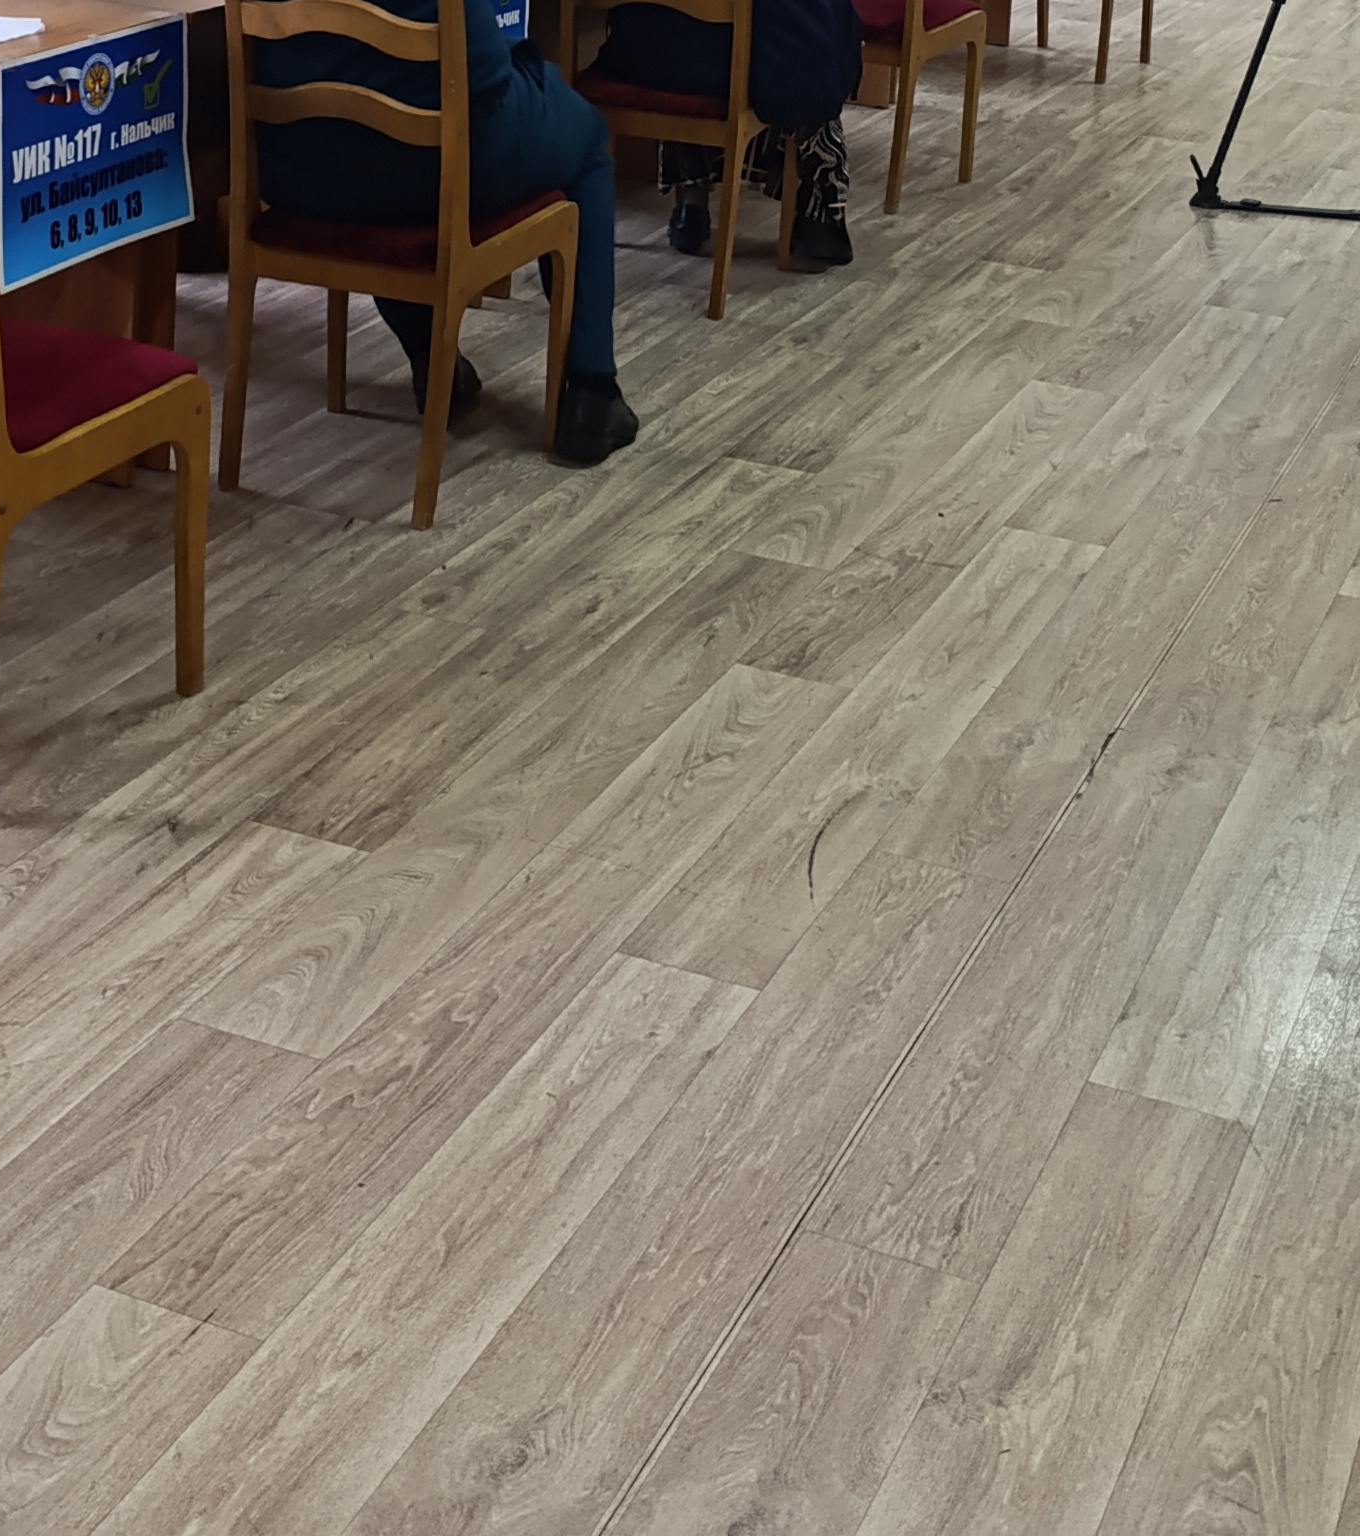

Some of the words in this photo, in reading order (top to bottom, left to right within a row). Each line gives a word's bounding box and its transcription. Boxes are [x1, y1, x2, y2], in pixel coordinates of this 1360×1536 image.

[12, 140, 51, 184] УИК
[54, 123, 102, 169] №117
[110, 132, 120, 150] г.
[121, 112, 175, 142] Нальчик
[21, 190, 45, 224] ул.
[48, 149, 168, 211] Байсултанова:
[50, 220, 64, 250] 6,
[68, 214, 81, 243] 8,
[85, 207, 98, 236] 9,
[101, 198, 122, 229] 10,
[124, 190, 142, 220] 13
